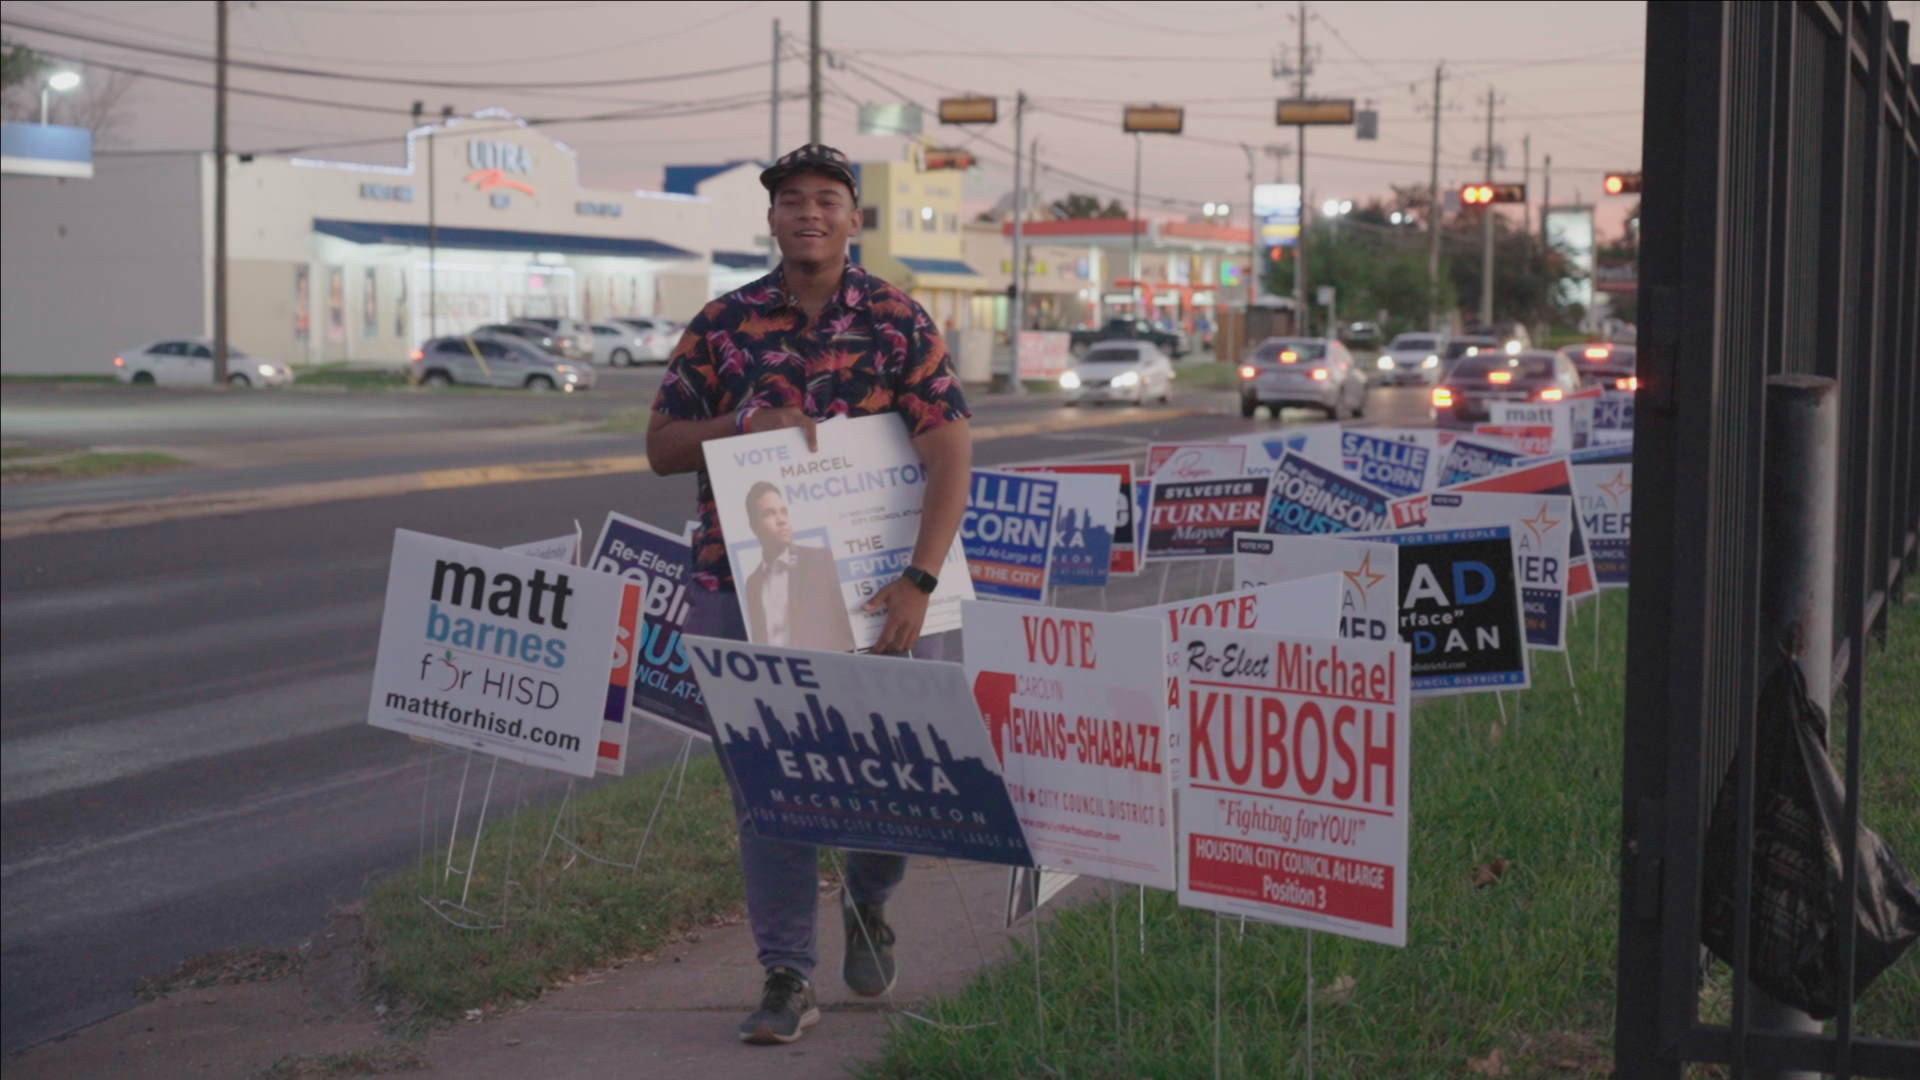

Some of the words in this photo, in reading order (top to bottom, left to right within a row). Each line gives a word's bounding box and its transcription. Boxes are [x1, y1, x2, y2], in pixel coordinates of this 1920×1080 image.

[733, 446, 791, 468] VOTE
[780, 456, 854, 478] MARCEL
[1343, 433, 1429, 470] SALLIE
[1165, 483, 1253, 499] SYLVESTER
[1363, 459, 1422, 489] CORN
[968, 476, 1054, 516] LLIE
[1152, 501, 1262, 525] TURNER
[1272, 470, 1387, 531] ROBINSON
[844, 535, 885, 554] THE
[960, 510, 1047, 548] CORN
[1171, 526, 1231, 546] Mayor
[609, 539, 685, 581] Re-Elect
[1011, 570, 1041, 584] CITY
[1519, 555, 1558, 584] ER
[431, 559, 573, 630] matt
[855, 581, 873, 597] IS
[425, 602, 567, 669] barnes
[1168, 595, 1258, 643] VOTE
[1022, 614, 1097, 670] VOTE
[692, 646, 821, 689] VOTE
[1187, 640, 1271, 678] Re-Elect
[1277, 641, 1395, 700] Michael
[482, 667, 560, 710] HISD
[1018, 674, 1064, 701] CAROLYN
[385, 692, 581, 752] mattforhisd.com
[1012, 707, 1163, 775] EVANS-SHABAZZ
[1189, 689, 1396, 807] KUBOSH
[776, 749, 959, 796] ERICKA
[770, 789, 987, 825] McCRUTCHEON
[1063, 791, 1106, 818] COUNCIL
[1109, 799, 1154, 826] DISTRICT
[1195, 837, 1253, 867] HOUSTON
[1255, 847, 1281, 872] CITY
[1282, 851, 1330, 881] COUNCIL
[1347, 866, 1385, 890] LARGE
[1262, 875, 1316, 908] Position
[1317, 886, 1328, 910] 3
